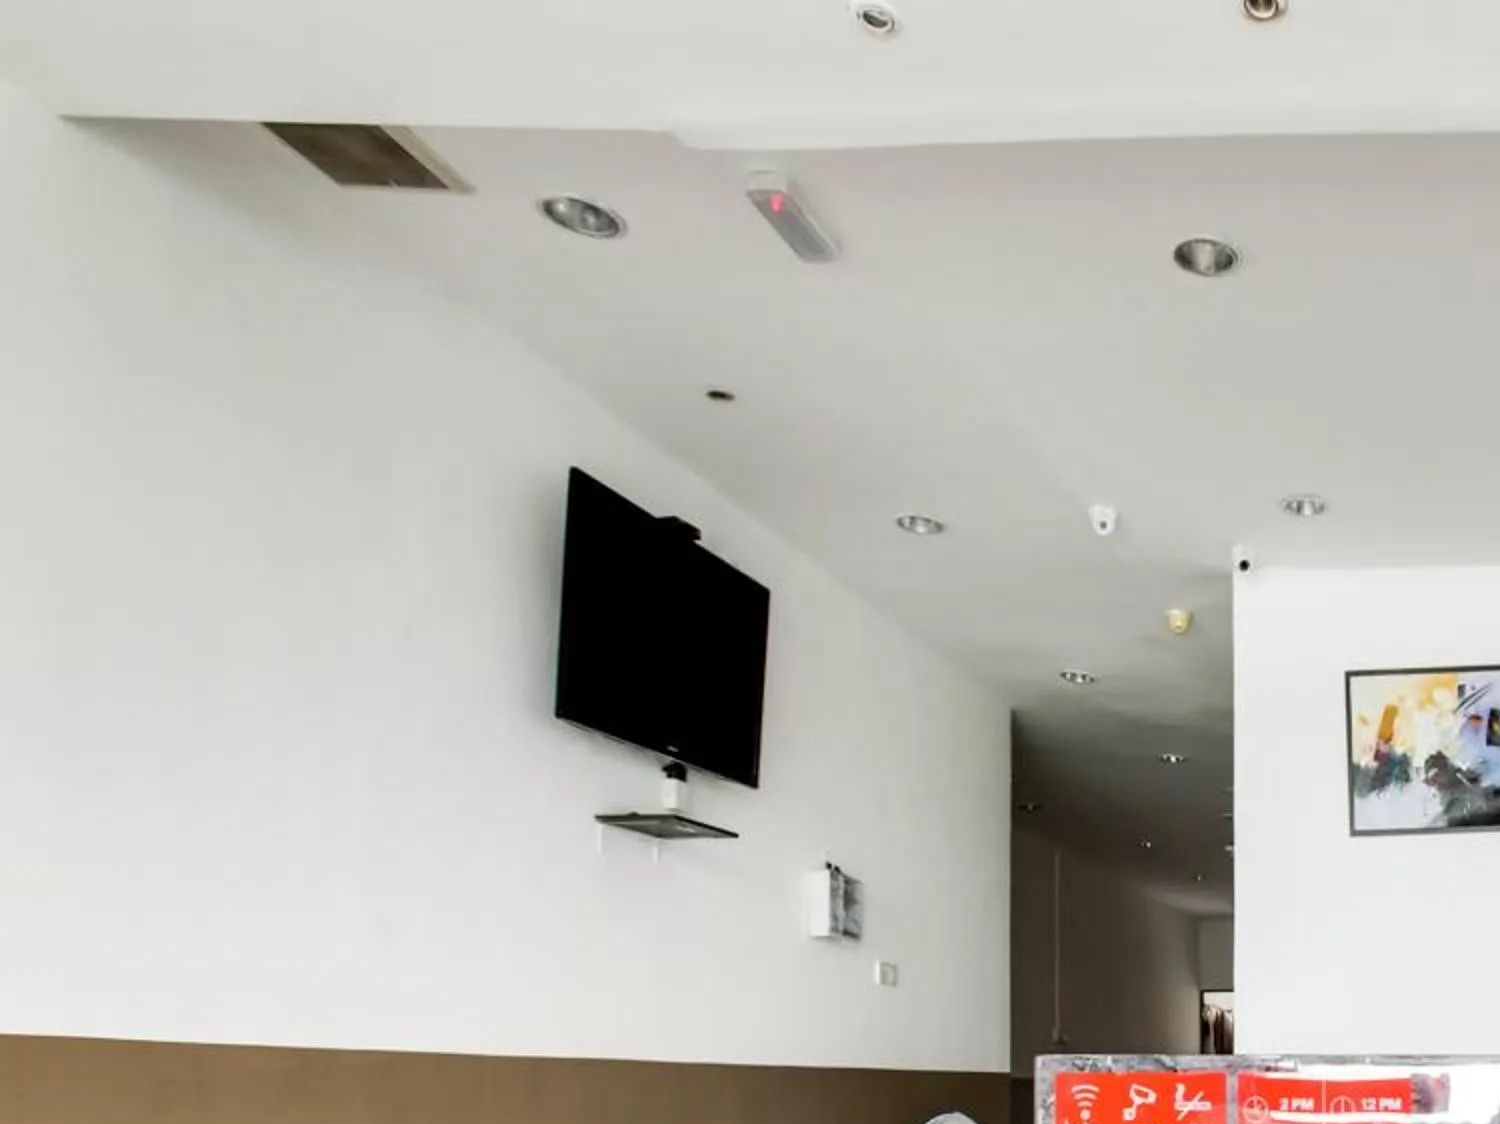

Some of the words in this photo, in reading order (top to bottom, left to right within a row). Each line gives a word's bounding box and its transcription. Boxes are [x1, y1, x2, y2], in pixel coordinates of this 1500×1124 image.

[1279, 1097, 1290, 1112] 2
[1291, 1097, 1315, 1112] PM
[1361, 1097, 1377, 1112] 12
[1379, 1097, 1402, 1112] PM
